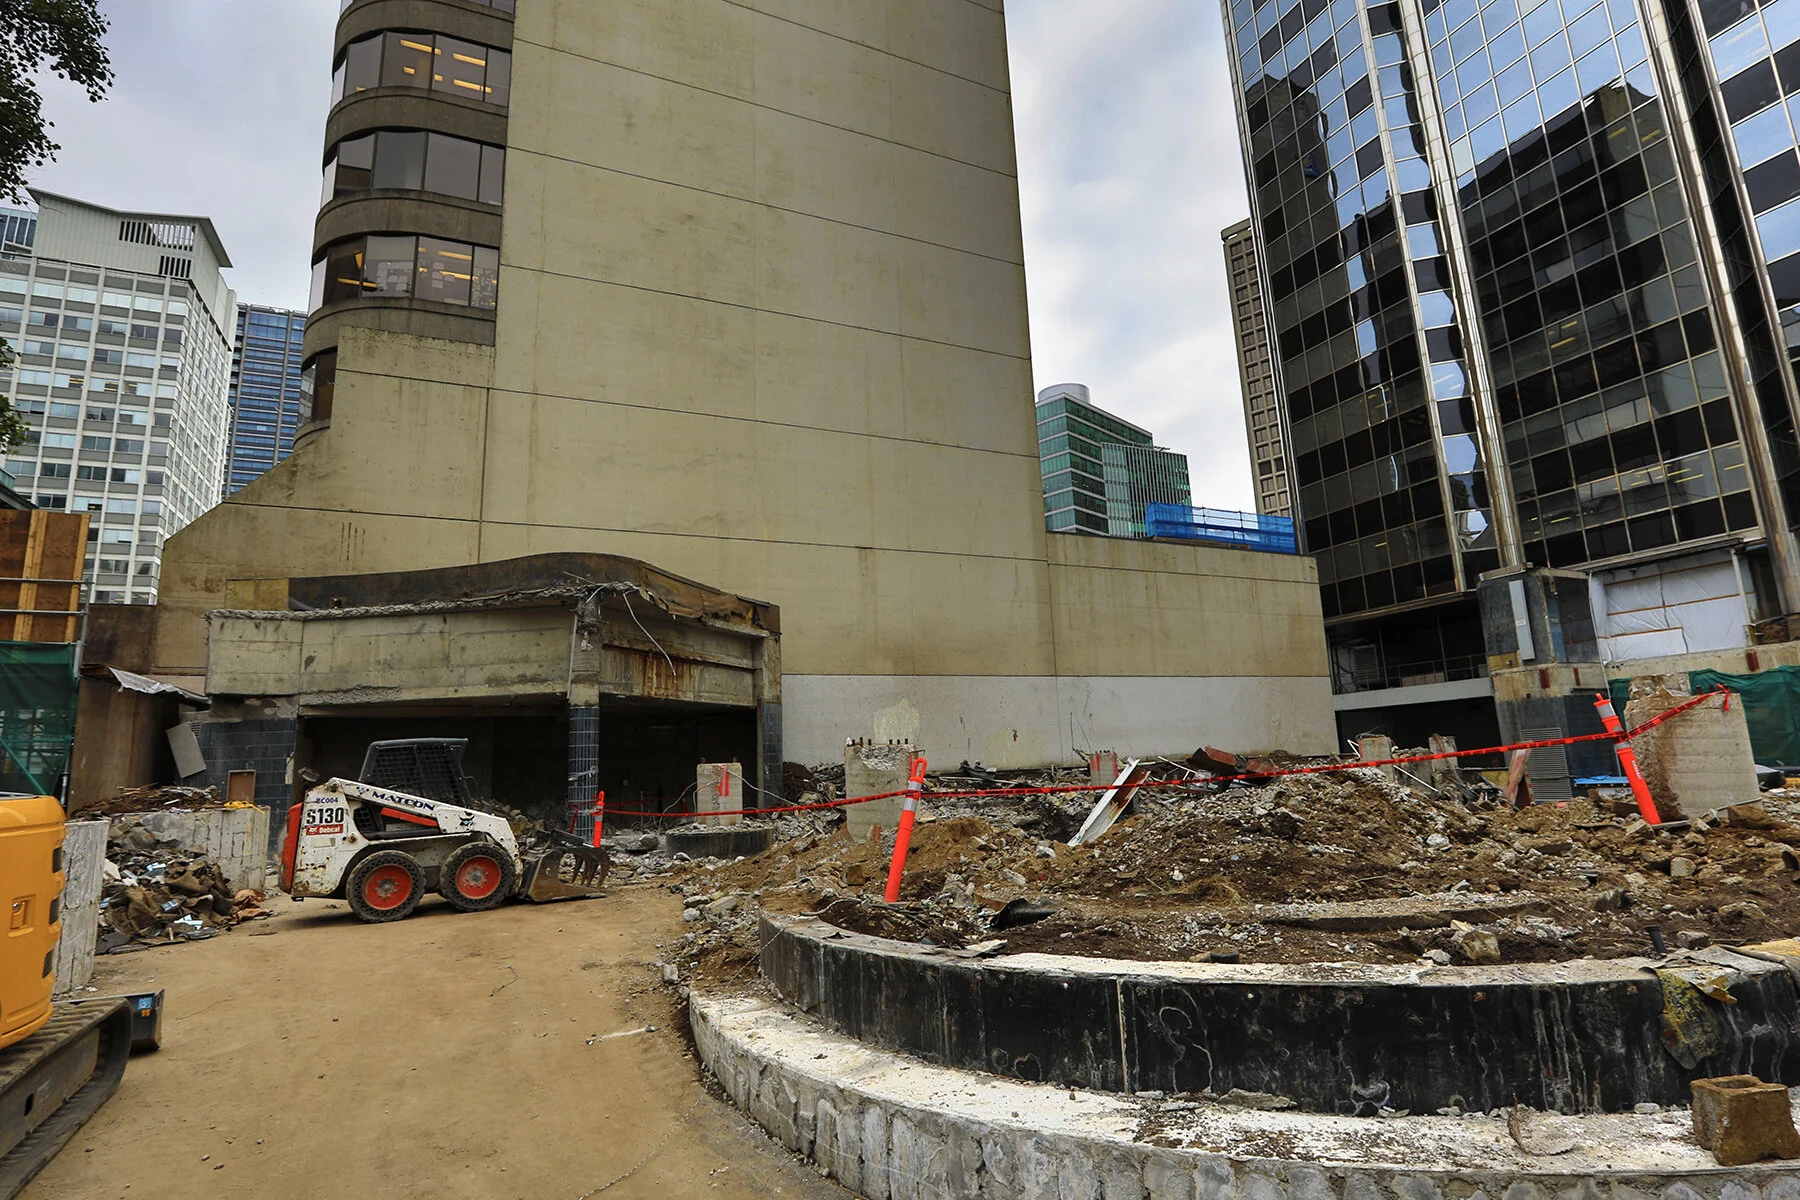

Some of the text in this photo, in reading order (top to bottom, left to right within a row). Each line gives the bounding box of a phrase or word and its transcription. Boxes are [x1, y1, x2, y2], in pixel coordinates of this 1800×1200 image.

[372, 791, 435, 811] MATCON
[306, 807, 345, 824] S130
[318, 826, 341, 834] Bobcat
